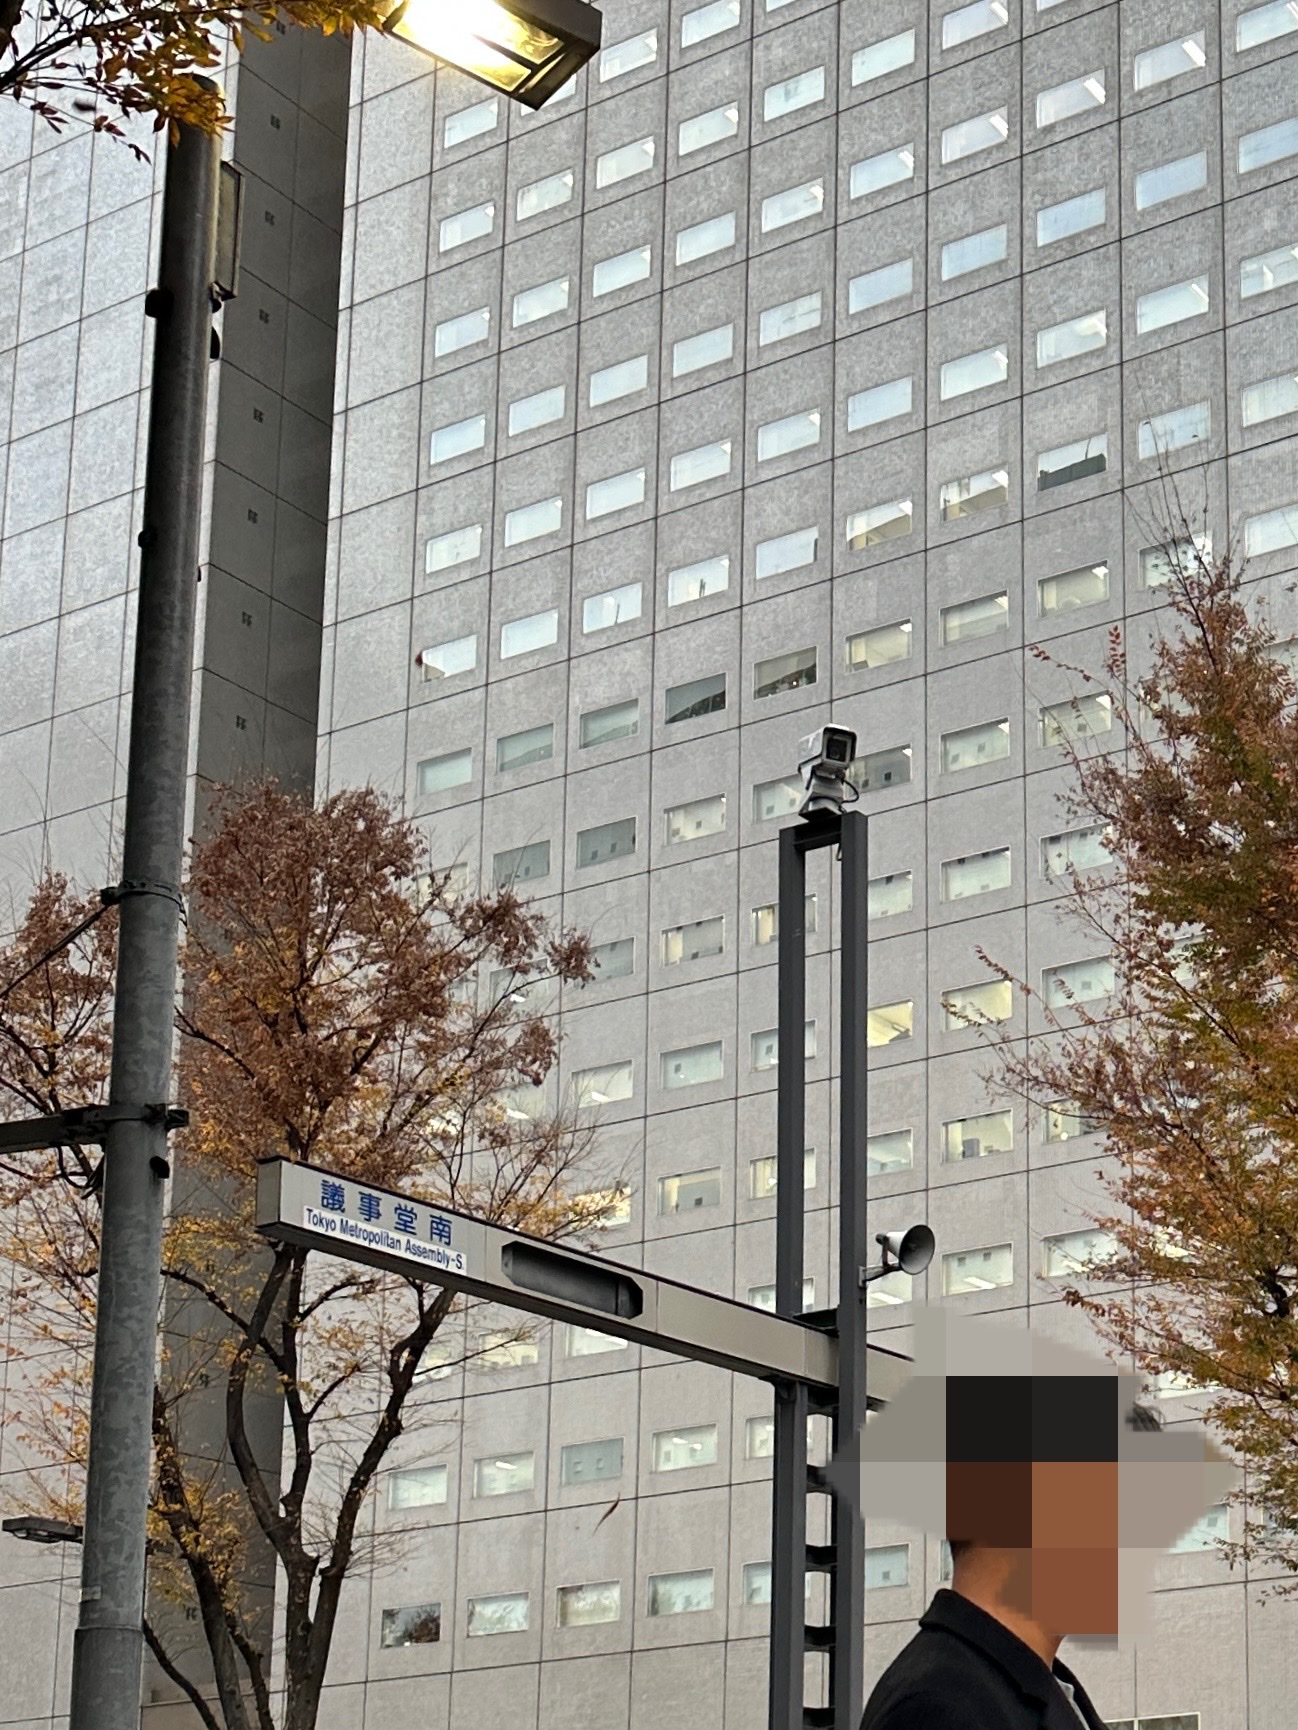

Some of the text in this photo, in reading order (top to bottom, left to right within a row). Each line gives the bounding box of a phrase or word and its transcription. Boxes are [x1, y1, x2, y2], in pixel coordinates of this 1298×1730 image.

[306, 1208, 337, 1232] Tokyo
[340, 1218, 401, 1250] Metropolitan
[320, 1179, 452, 1246] 議事堂南
